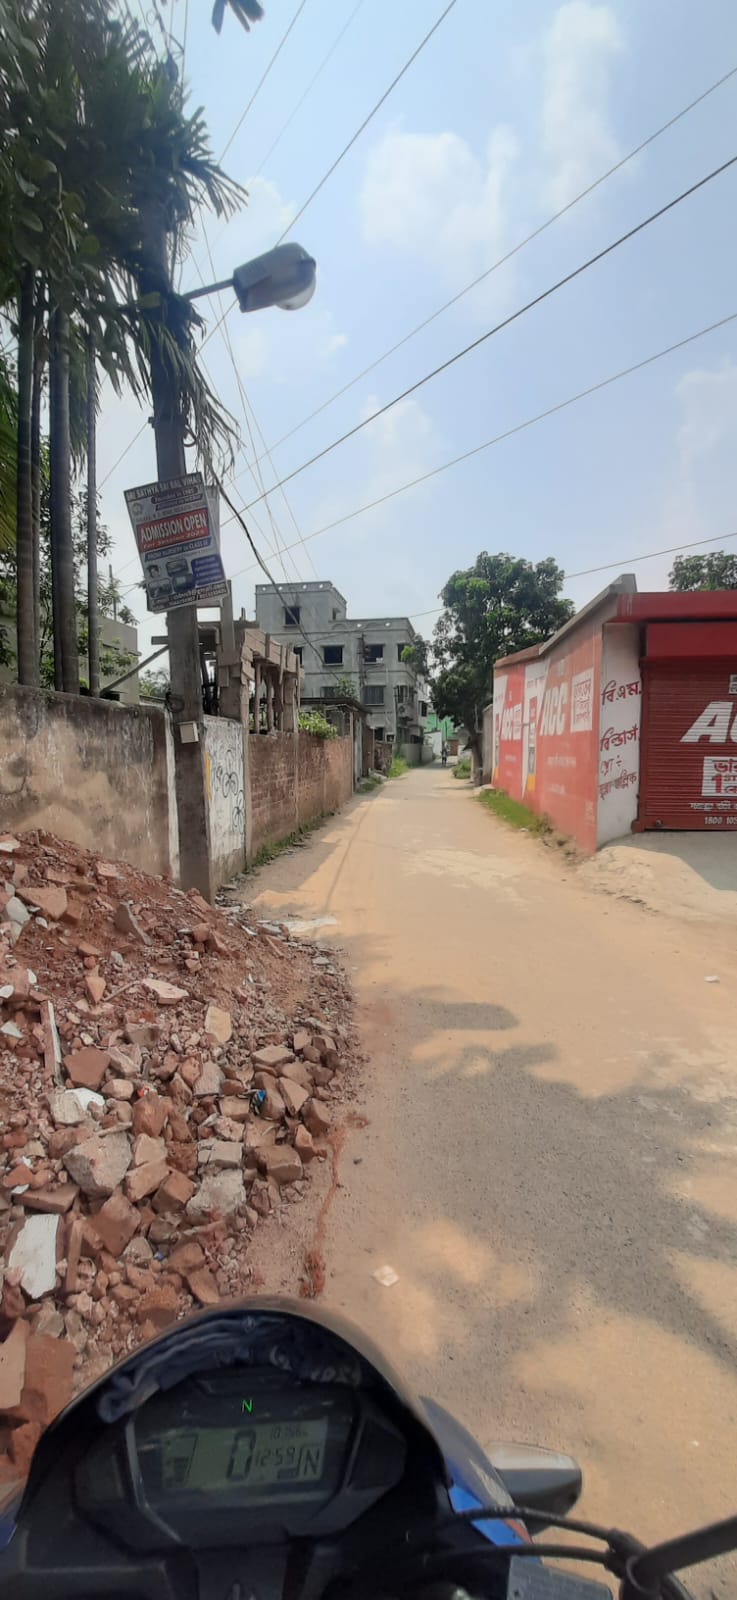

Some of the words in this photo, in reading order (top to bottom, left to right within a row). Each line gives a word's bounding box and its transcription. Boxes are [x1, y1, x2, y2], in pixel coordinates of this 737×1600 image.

[136, 486, 158, 500] SATHYA
[141, 518, 184, 544] ADMISSION
[184, 512, 207, 532] OPEN
[540, 682, 568, 736] ACC
[679, 700, 737, 743] A
[704, 816, 723, 825] 1800
[241, 1399, 253, 1413] N
[226, 1430, 257, 1481] 0
[254, 1447, 296, 1468] 12:59
[303, 1448, 321, 1476] N
